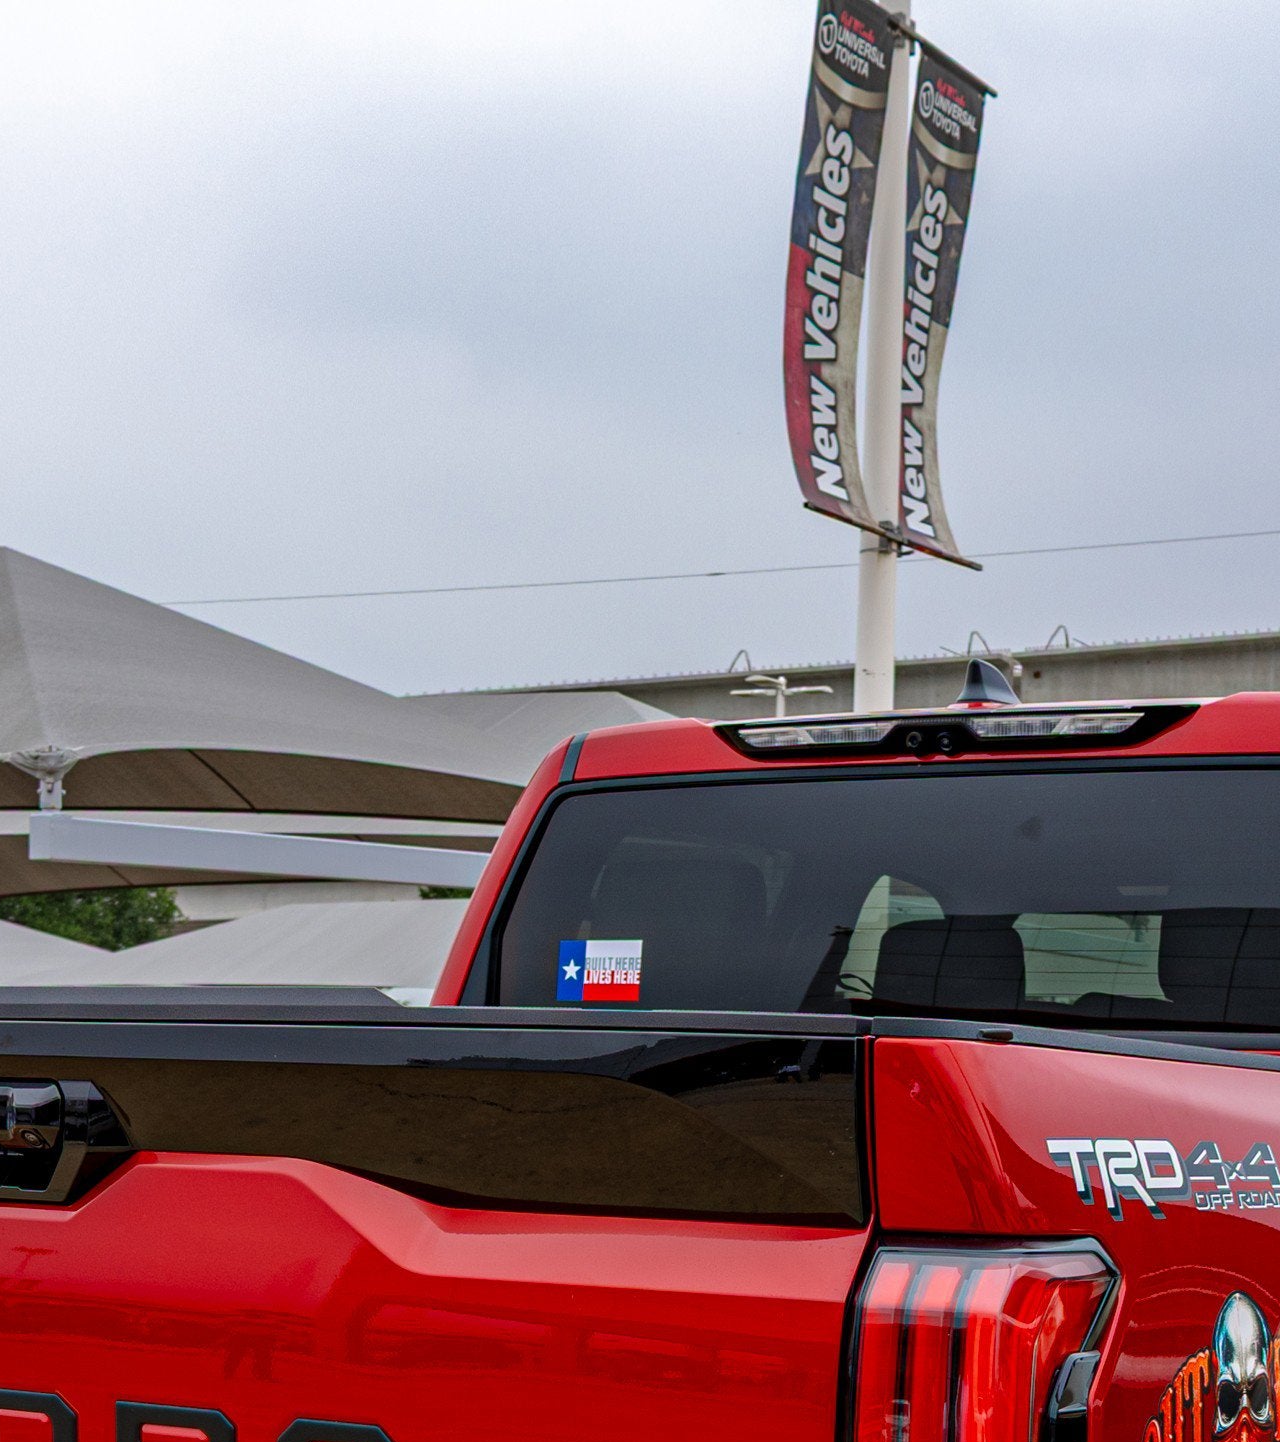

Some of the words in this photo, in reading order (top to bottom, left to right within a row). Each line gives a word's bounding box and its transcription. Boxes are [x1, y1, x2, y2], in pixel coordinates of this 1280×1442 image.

[835, 44, 869, 78] TOYOTA
[837, 25, 886, 70] UNIVERSAL
[932, 109, 960, 141] TOYOTA
[935, 92, 977, 133] UNIVERSAL
[803, 123, 854, 360] Vehicles
[901, 183, 948, 404] Vehicles
[809, 373, 851, 502] New
[901, 417, 936, 538] New
[584, 970, 613, 984] LIVES
[614, 970, 640, 984] HERE
[585, 957, 614, 971] BUILT
[615, 957, 641, 971] HERE
[1045, 1137, 1190, 1221] TRD
[1195, 1189, 1235, 1211] OFF
